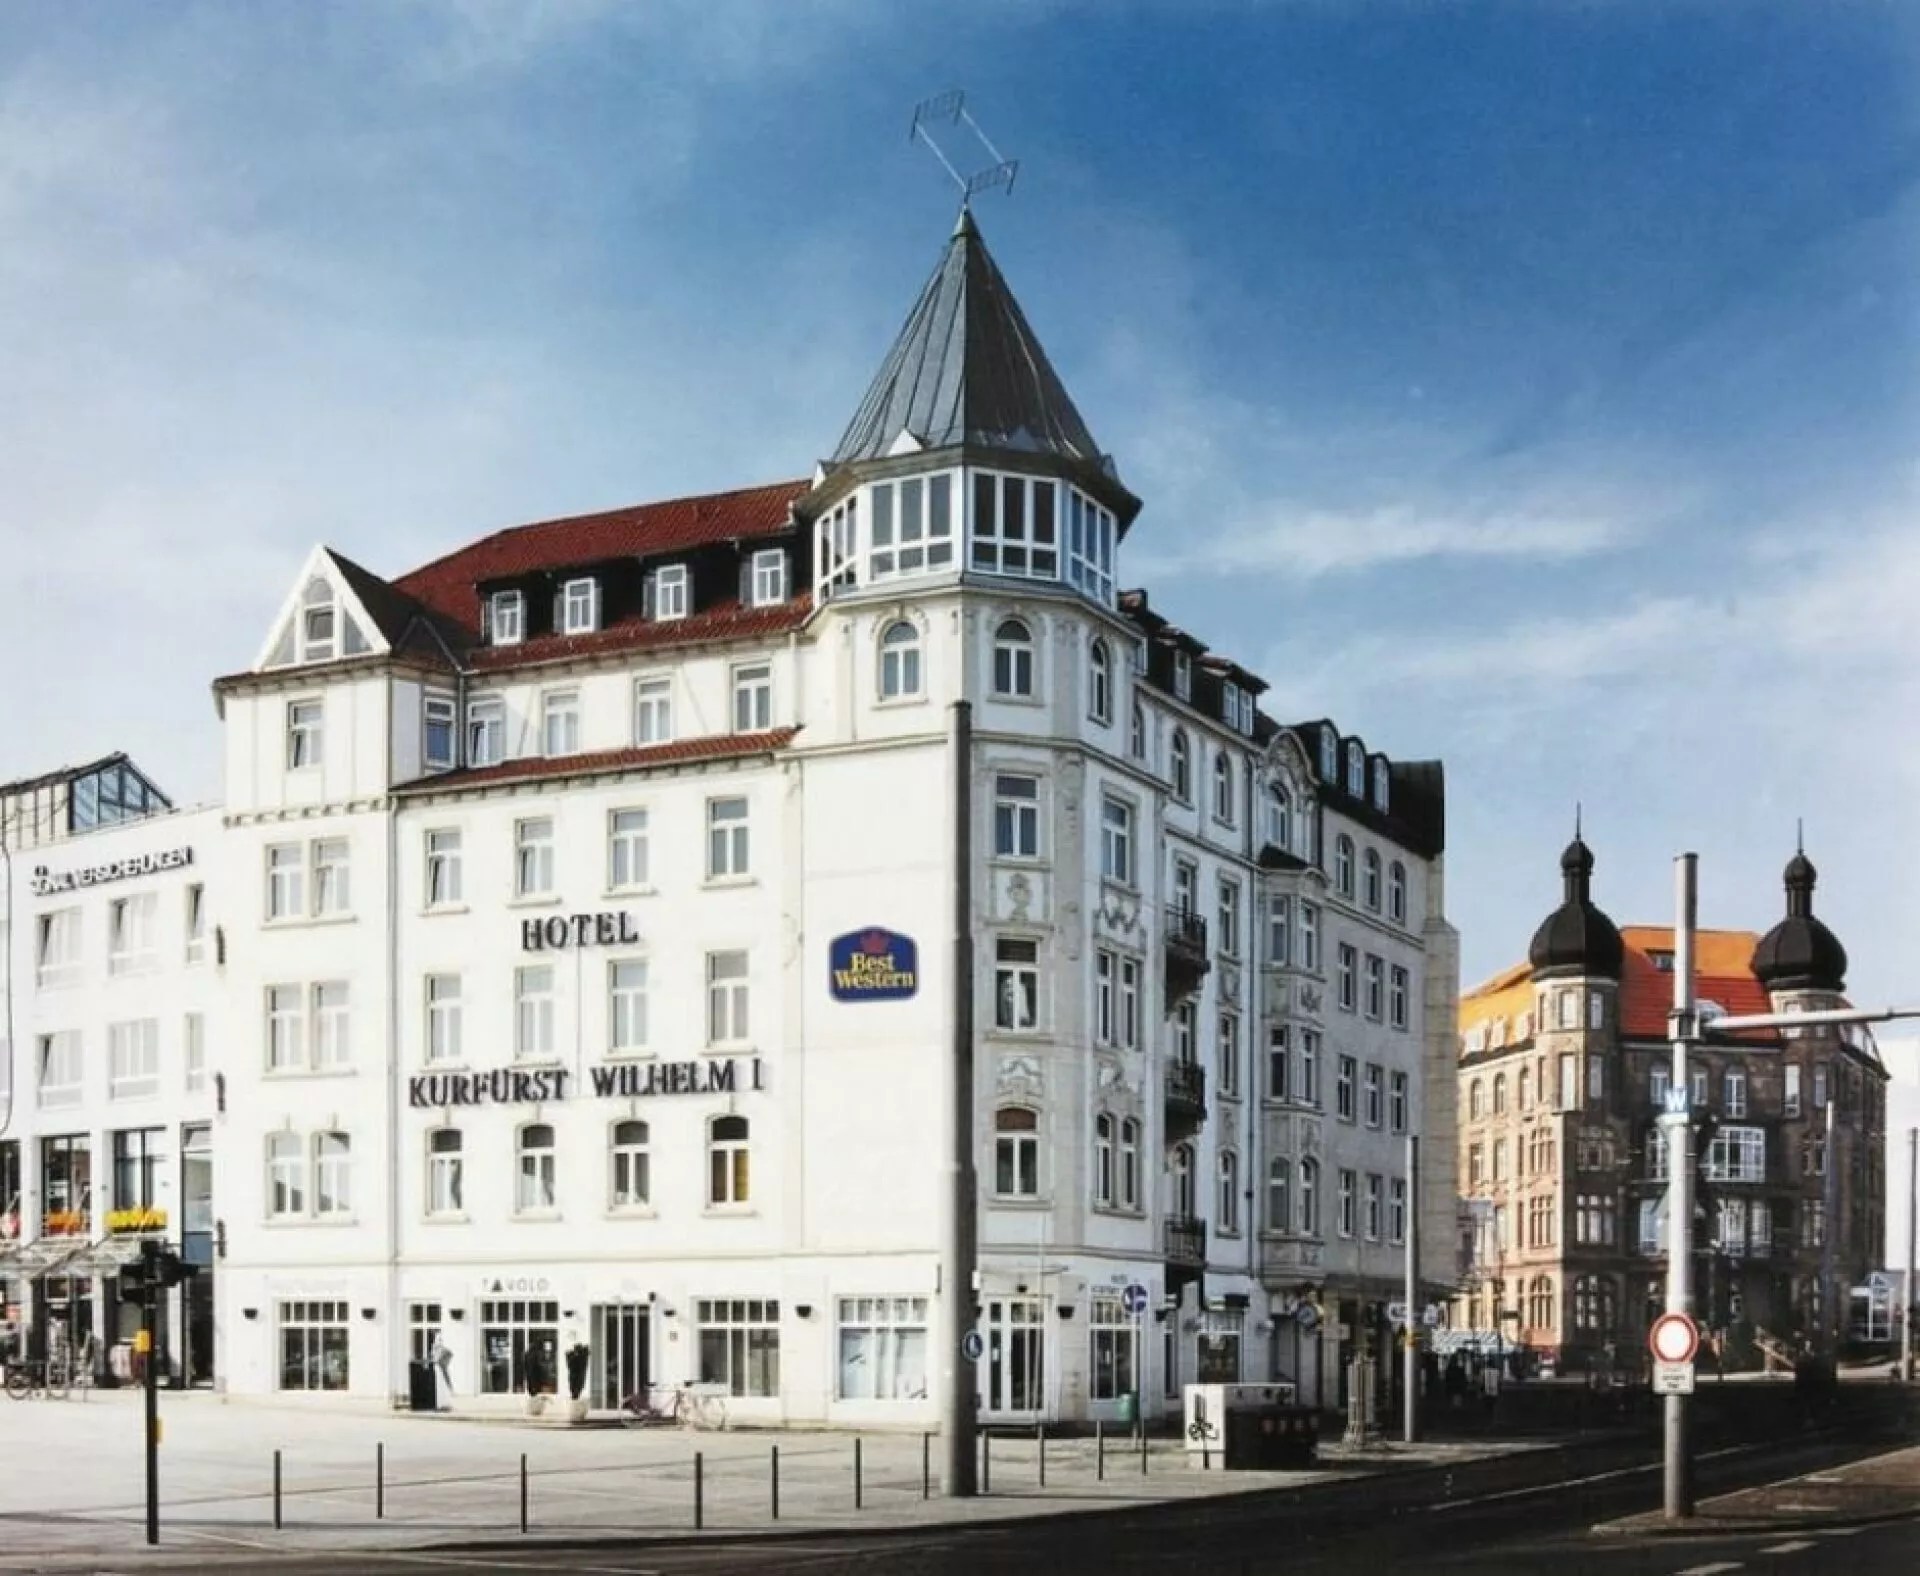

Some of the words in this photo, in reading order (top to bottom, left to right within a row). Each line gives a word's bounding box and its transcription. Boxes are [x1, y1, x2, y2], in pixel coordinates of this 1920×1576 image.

[521, 910, 639, 951] HOTEL
[850, 952, 895, 973] Best
[834, 969, 914, 989] Western
[590, 1058, 737, 1097] WILHELM
[751, 1057, 765, 1091] I
